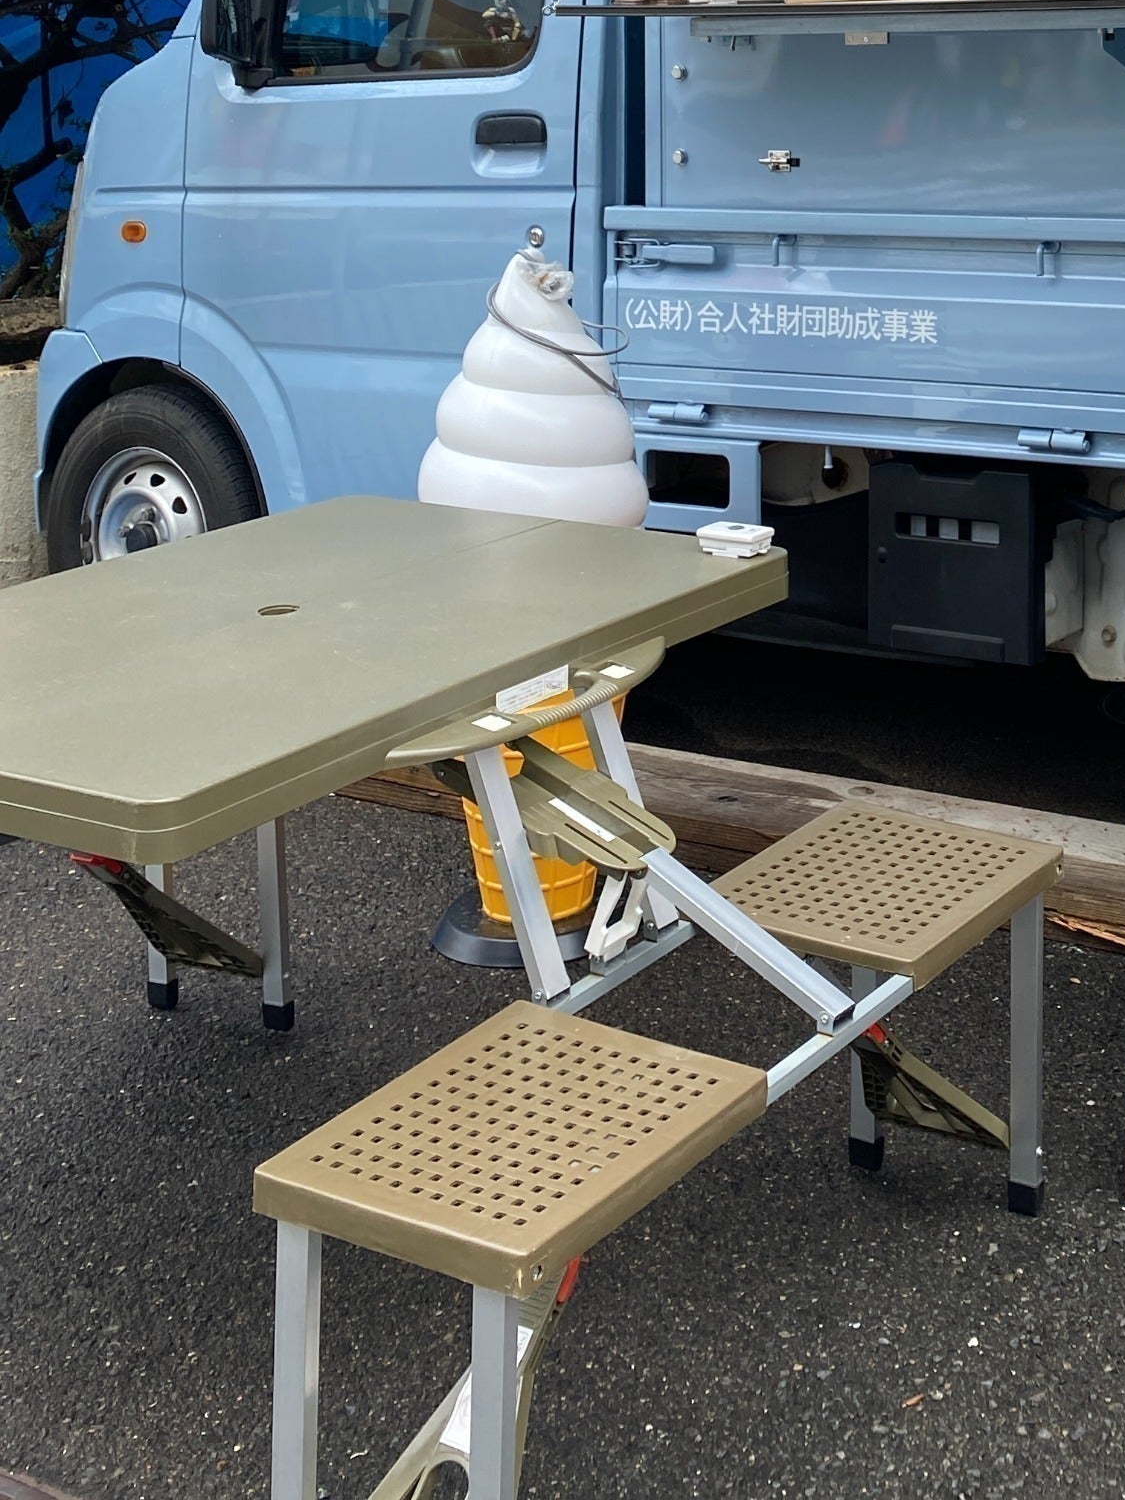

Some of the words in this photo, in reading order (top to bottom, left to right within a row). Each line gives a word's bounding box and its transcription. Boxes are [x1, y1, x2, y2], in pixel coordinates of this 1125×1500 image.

[625, 297, 938, 344] (公財)合人社財団助成事業
